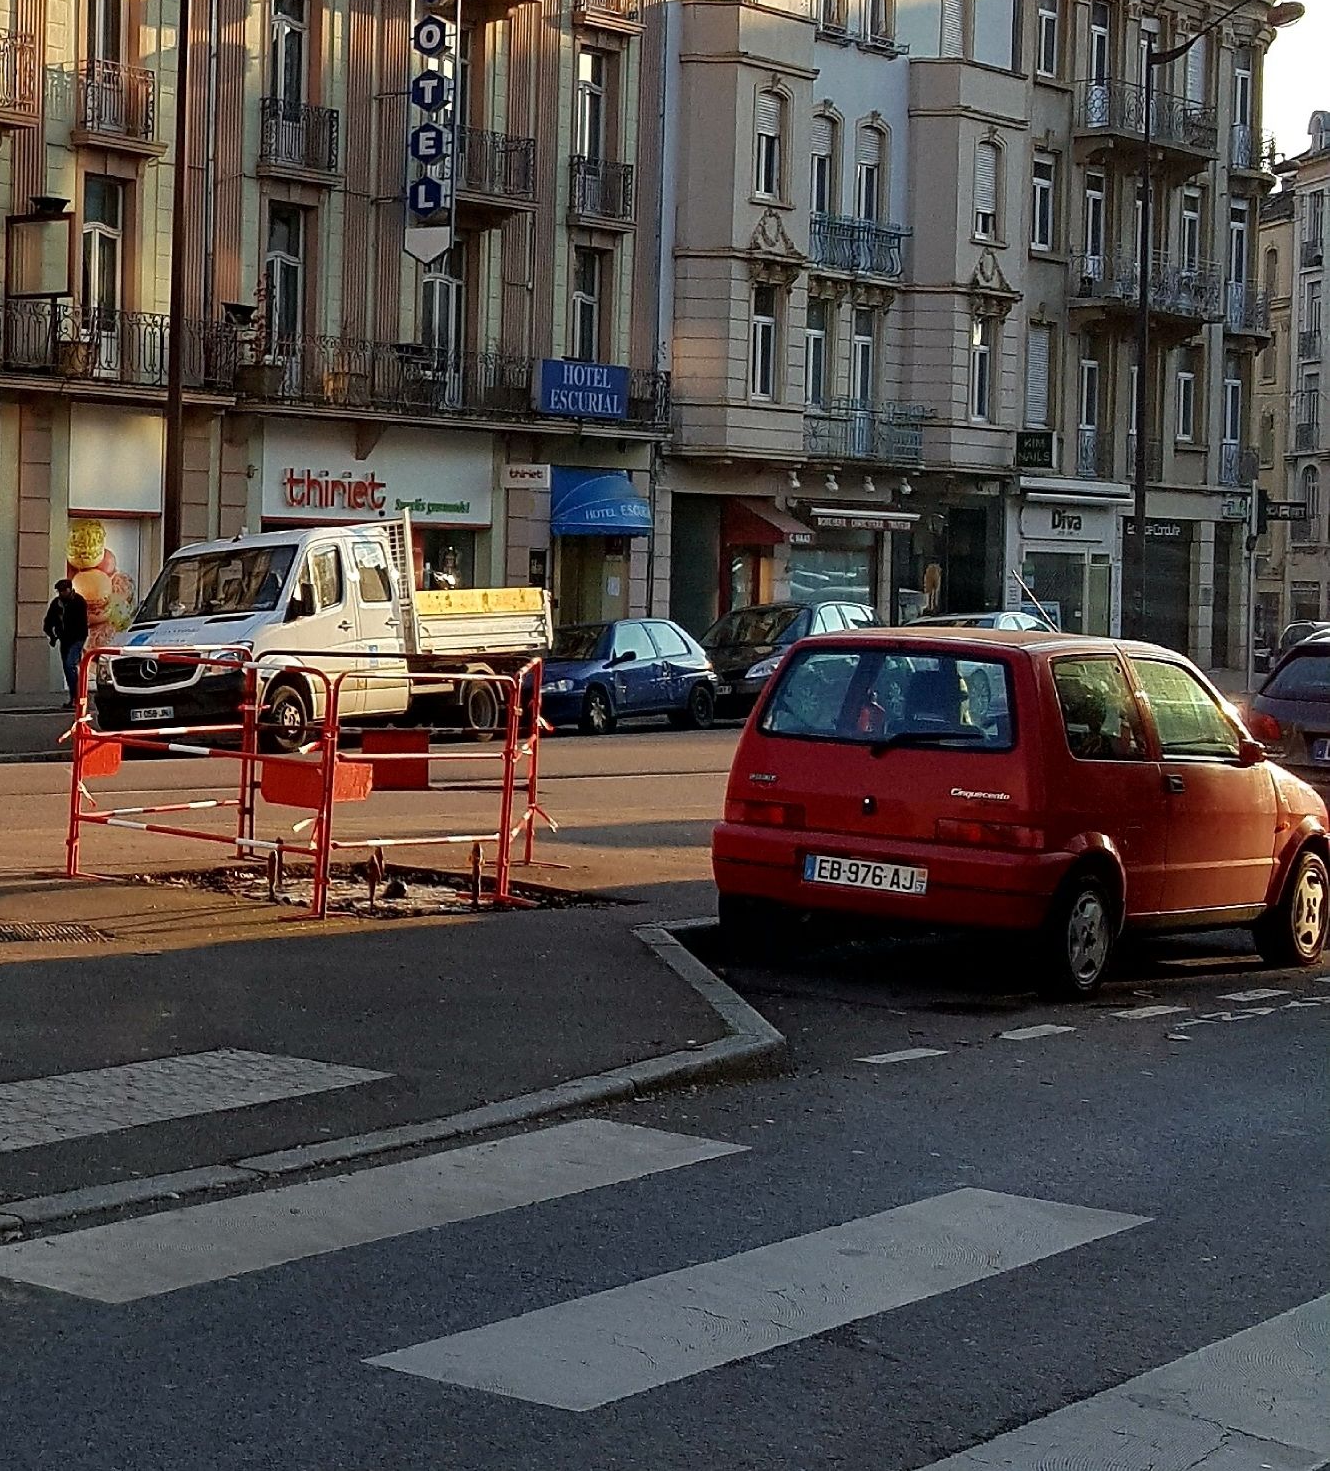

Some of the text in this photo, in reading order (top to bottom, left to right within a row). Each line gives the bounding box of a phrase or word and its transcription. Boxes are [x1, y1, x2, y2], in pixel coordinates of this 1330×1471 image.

[563, 365, 611, 389] HOTEL
[550, 389, 622, 414] ESCURIAL
[1017, 451, 1050, 462] NAILS
[509, 468, 544, 479] thiriet
[282, 468, 386, 510] thiriet
[585, 508, 616, 520] HOTEL
[1052, 509, 1081, 530] Diva
[951, 787, 1010, 799] Cinquecento
